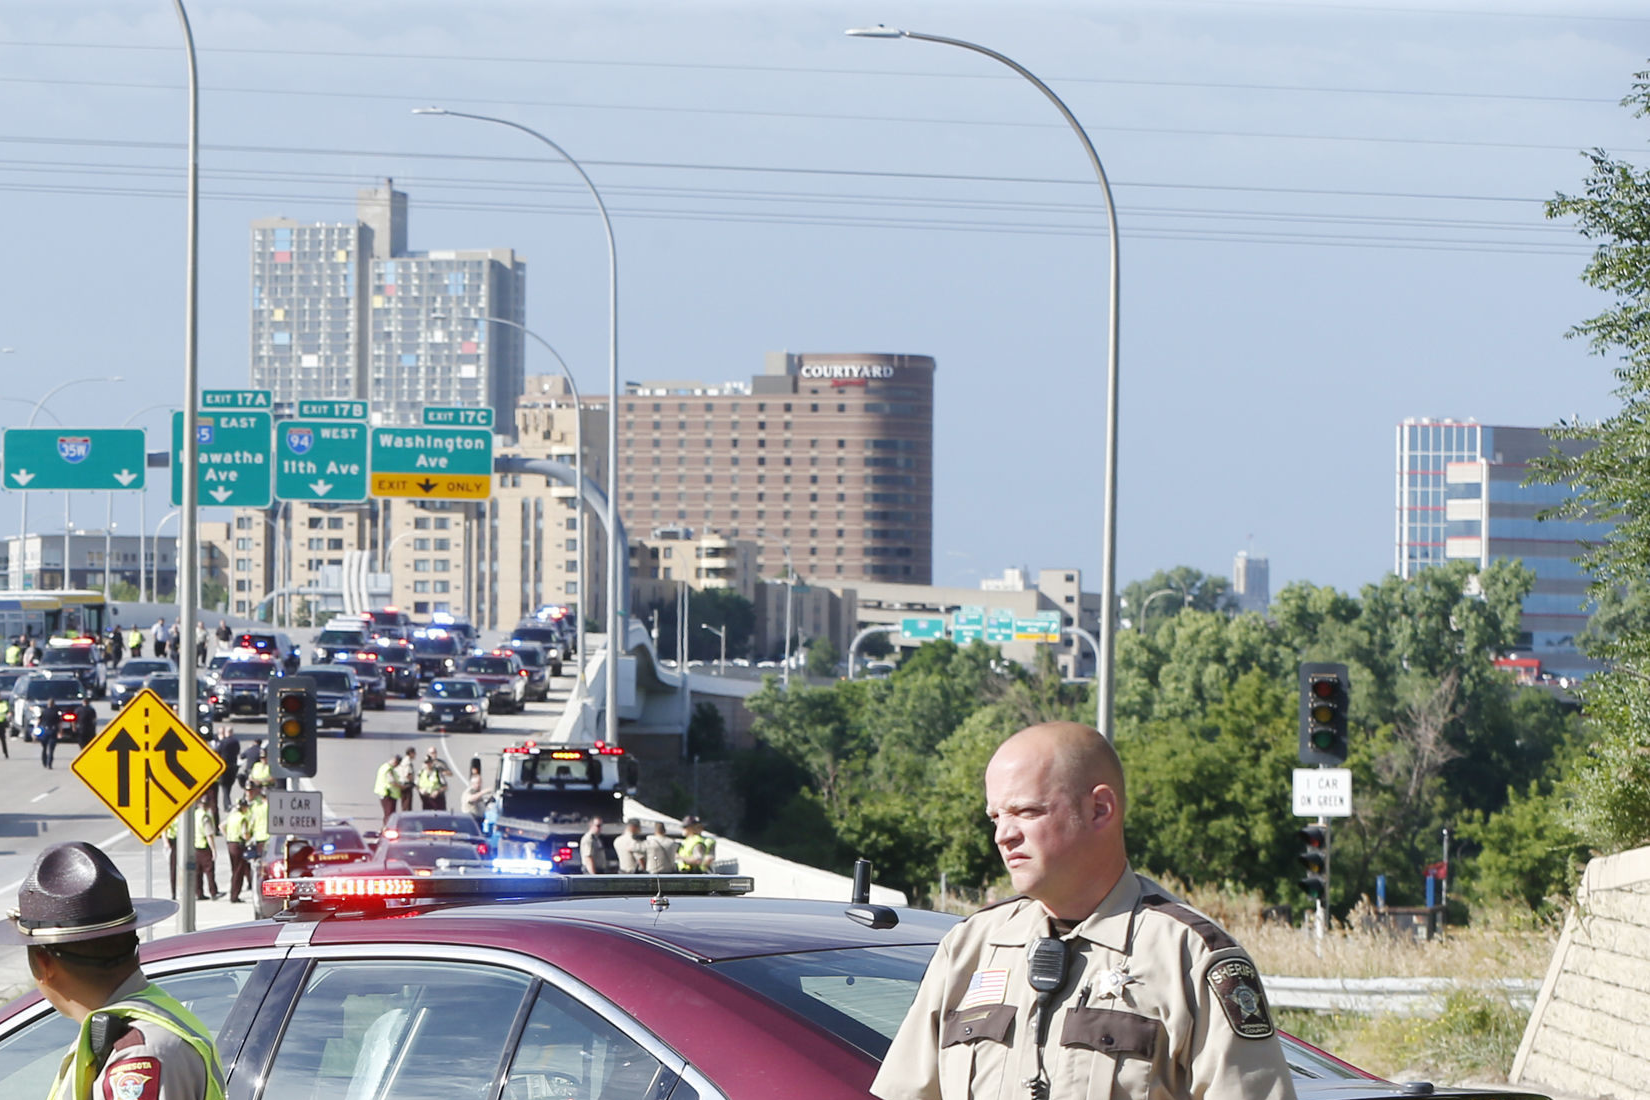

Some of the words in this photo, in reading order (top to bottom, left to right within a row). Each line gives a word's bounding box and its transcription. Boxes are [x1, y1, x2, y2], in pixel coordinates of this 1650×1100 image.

[801, 364, 894, 378] COURTYARD
[206, 394, 232, 404] EXIT
[237, 393, 267, 406] 17A
[302, 405, 328, 415] EXIT
[334, 404, 364, 417] 17B
[220, 417, 257, 428] EAST
[428, 411, 454, 421] EXIT
[459, 411, 488, 424] 17C
[320, 428, 358, 439] WEST
[290, 435, 310, 448] 94
[379, 434, 485, 453] Washington
[61, 444, 86, 458] 35W
[179, 451, 264, 464] awatha
[283, 460, 317, 474] 11th
[326, 461, 360, 475] Ave
[415, 454, 449, 469] Ave
[204, 467, 239, 482] Ave
[377, 480, 408, 491] EXIT
[446, 481, 483, 493] ONLY
[1318, 777, 1338, 790] CAR
[290, 799, 311, 810] CAR
[1317, 795, 1344, 807] GREEN
[273, 816, 284, 827] ON
[290, 816, 317, 827] GREEN
